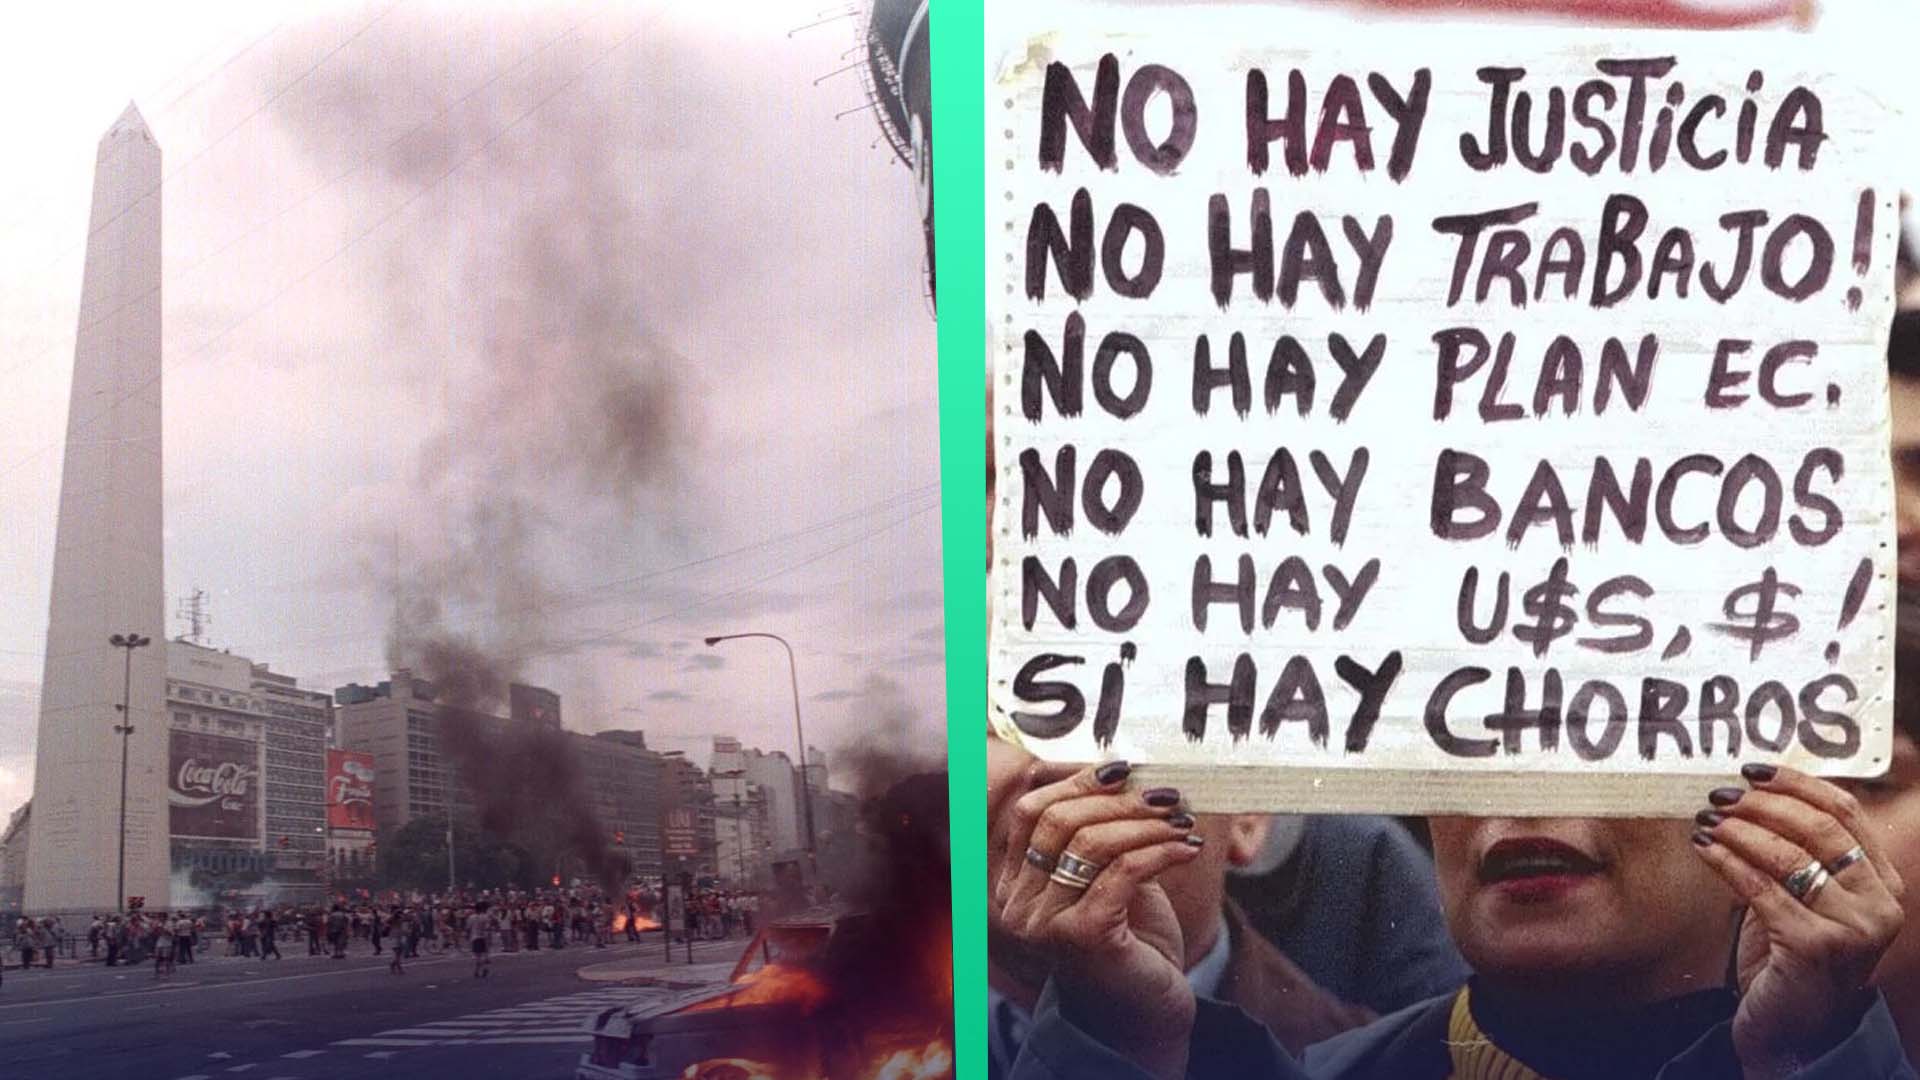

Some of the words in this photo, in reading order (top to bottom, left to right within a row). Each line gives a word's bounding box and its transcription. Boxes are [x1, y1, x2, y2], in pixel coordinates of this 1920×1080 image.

[1039, 53, 1198, 175] NO
[1246, 67, 1432, 184] HAY
[1026, 187, 1165, 304] NO
[1208, 187, 1393, 311] HAY
[1021, 310, 1153, 424] NO
[1192, 331, 1387, 424] HAY
[1432, 328, 1659, 424] PLAN
[1704, 339, 1841, 409] EC.
[1019, 444, 1144, 541] NO
[1192, 447, 1370, 548] HAY
[1430, 447, 1844, 550] BANCOS
[1022, 555, 1150, 633] NO
[1191, 554, 1381, 635] HAY
[1183, 651, 1403, 754] HAY
[1423, 665, 1861, 761] CHORROS
